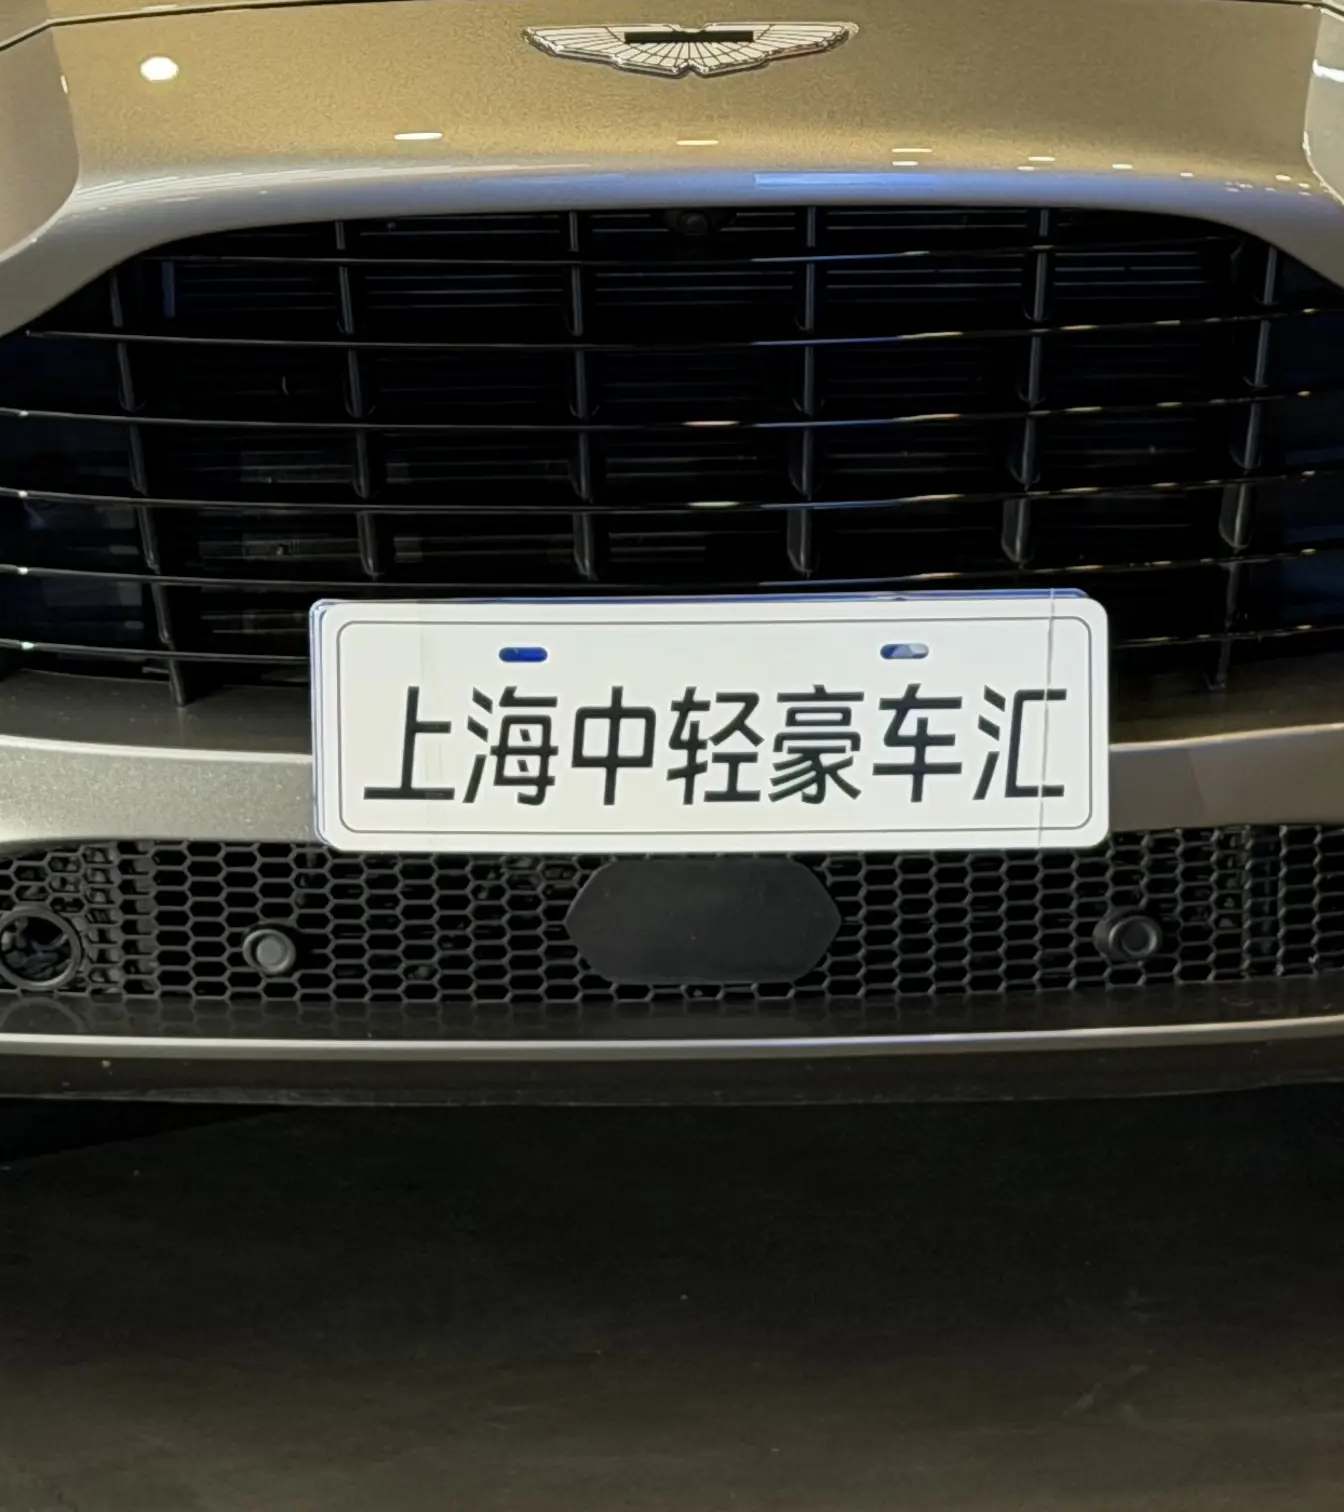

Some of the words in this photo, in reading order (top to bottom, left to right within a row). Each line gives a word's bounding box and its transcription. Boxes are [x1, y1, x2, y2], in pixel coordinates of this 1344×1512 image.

[362, 683, 1068, 806] 上海中轻豪车汇
